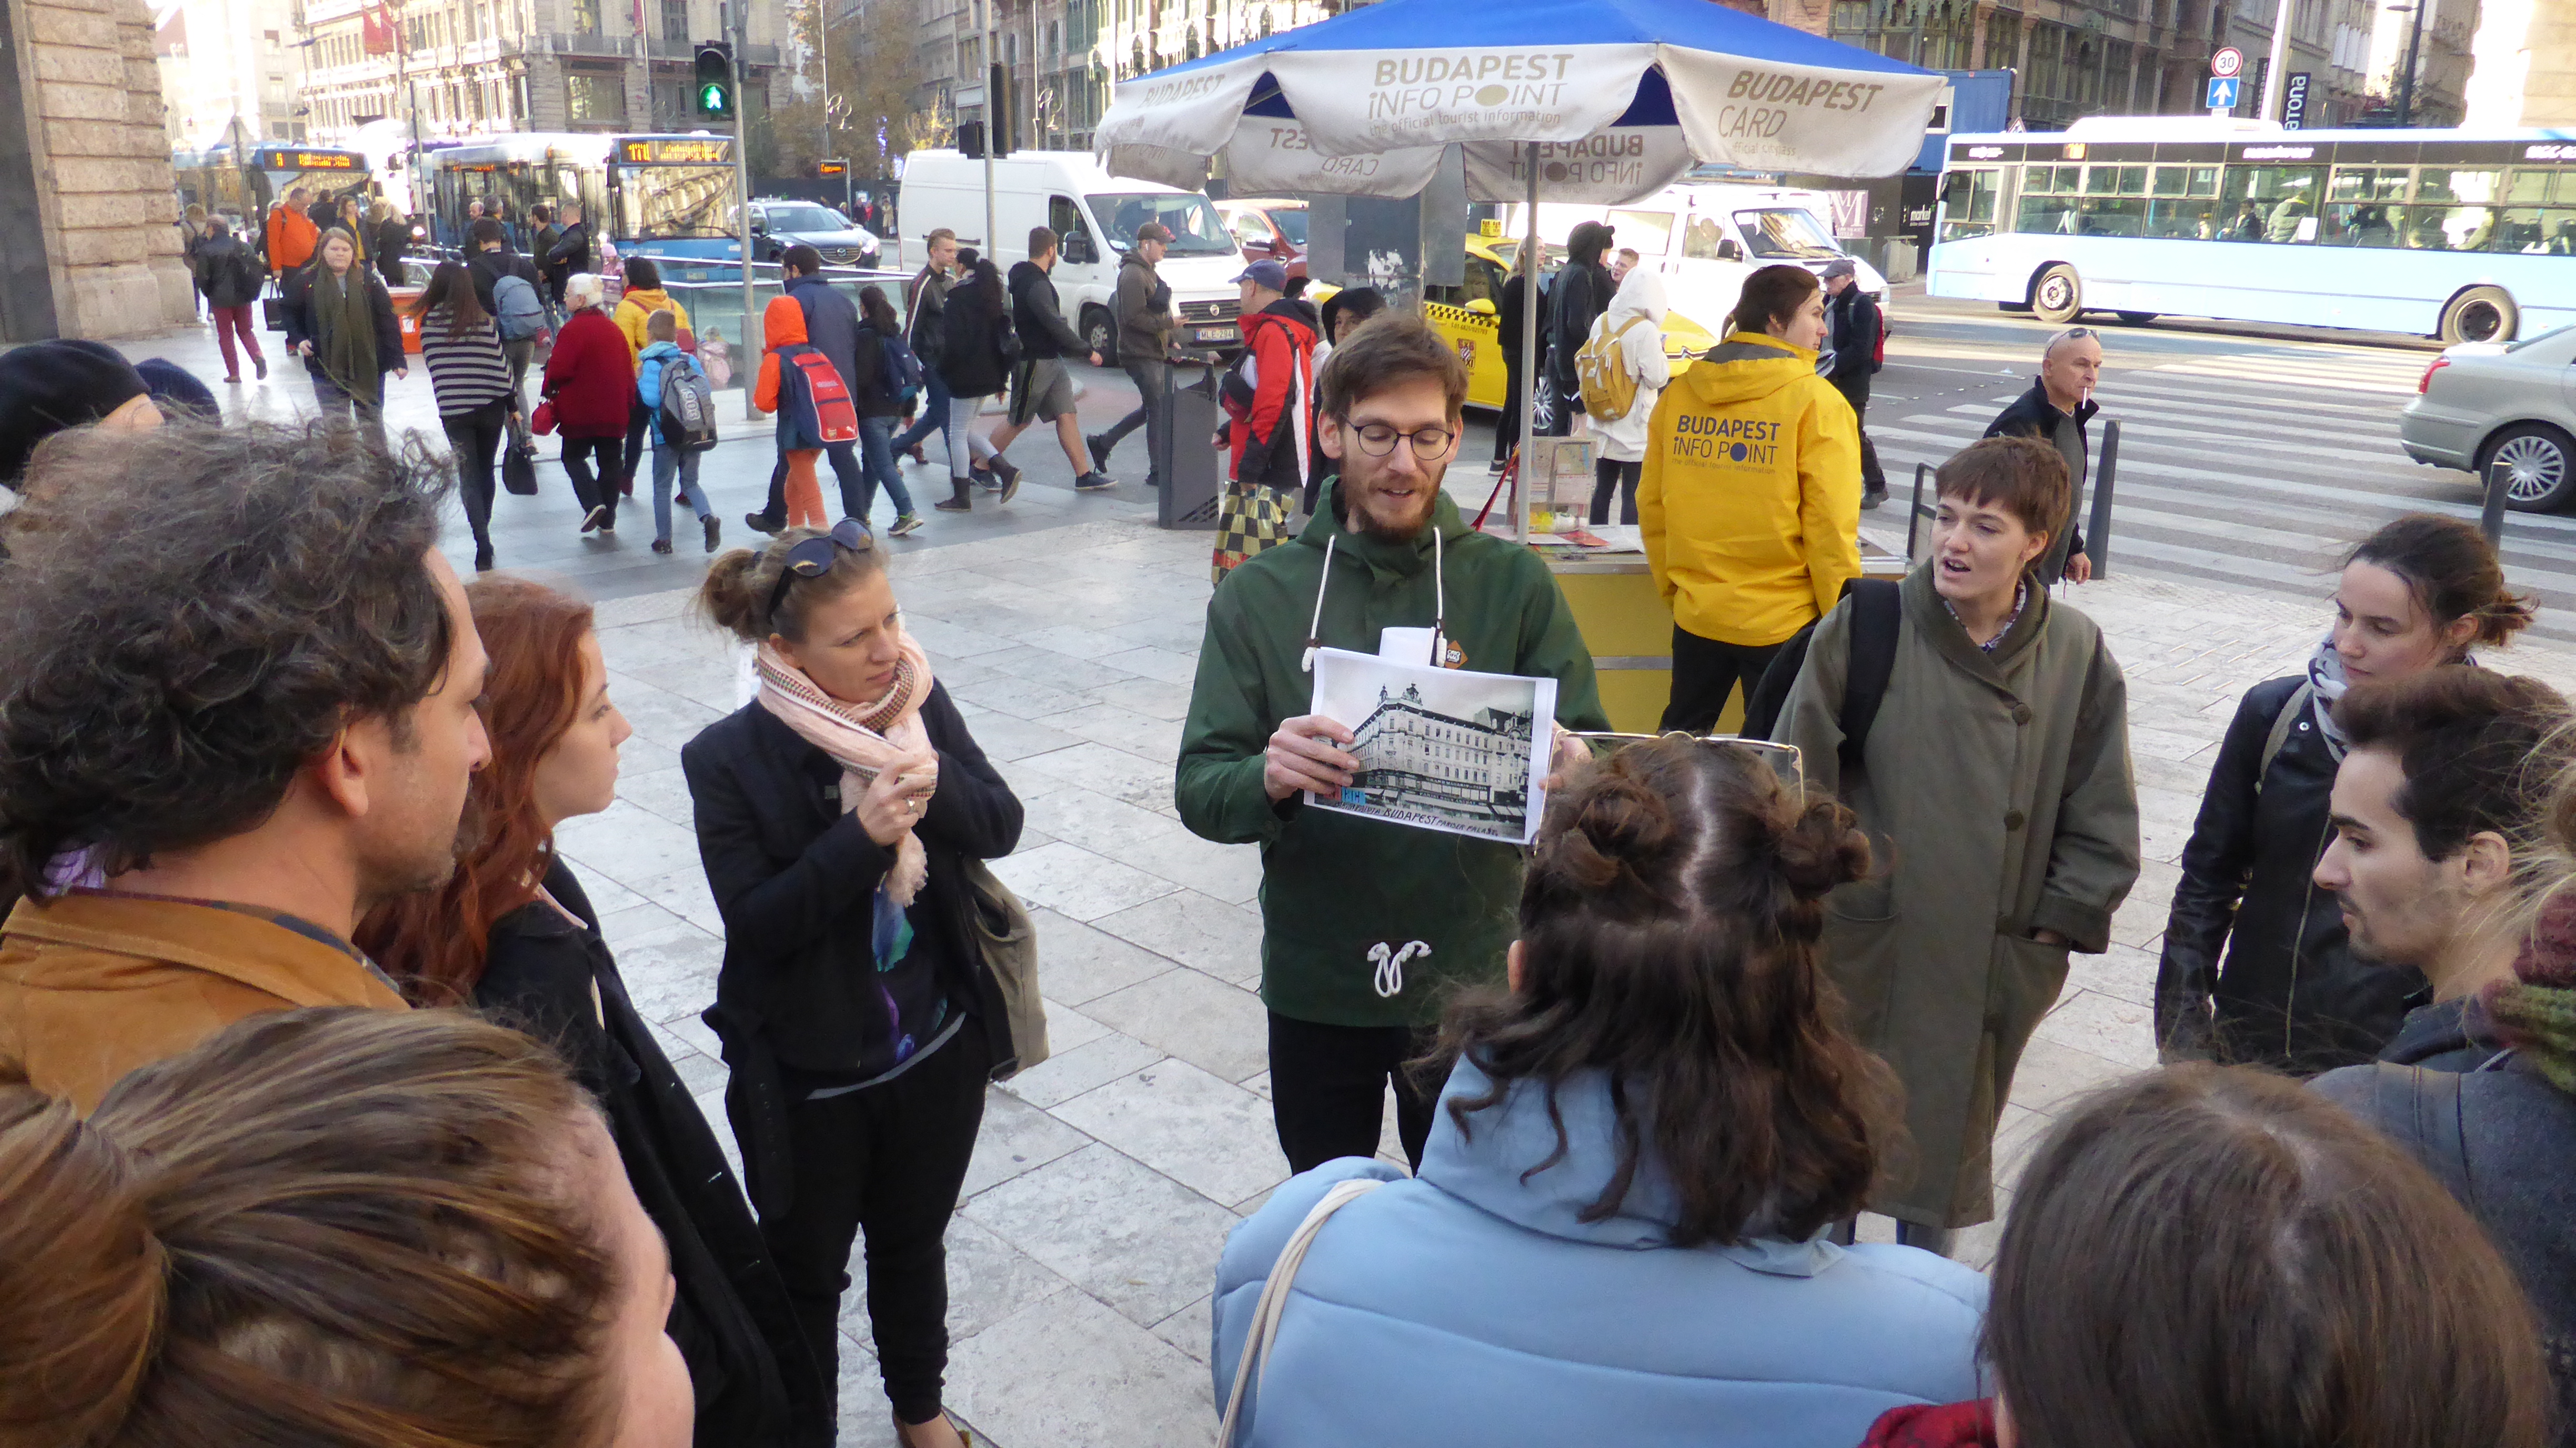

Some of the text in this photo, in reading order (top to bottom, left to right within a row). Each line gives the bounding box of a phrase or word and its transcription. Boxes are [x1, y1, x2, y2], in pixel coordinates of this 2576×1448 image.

[1374, 54, 1574, 86] BUDAPEST
[2219, 57, 2235, 68] 30
[1452, 83, 1567, 108] POINT
[1727, 71, 1884, 112] BUDAPEST
[1370, 108, 1561, 137] the official tourist information
[1718, 105, 1787, 137] CARD
[1677, 415, 1780, 441] BUDAPEST
[1717, 441, 1778, 465] POINT
[1685, 459, 1707, 468] official
[1735, 464, 1775, 474] information
[1383, 808, 1438, 825] BUDAPEST
